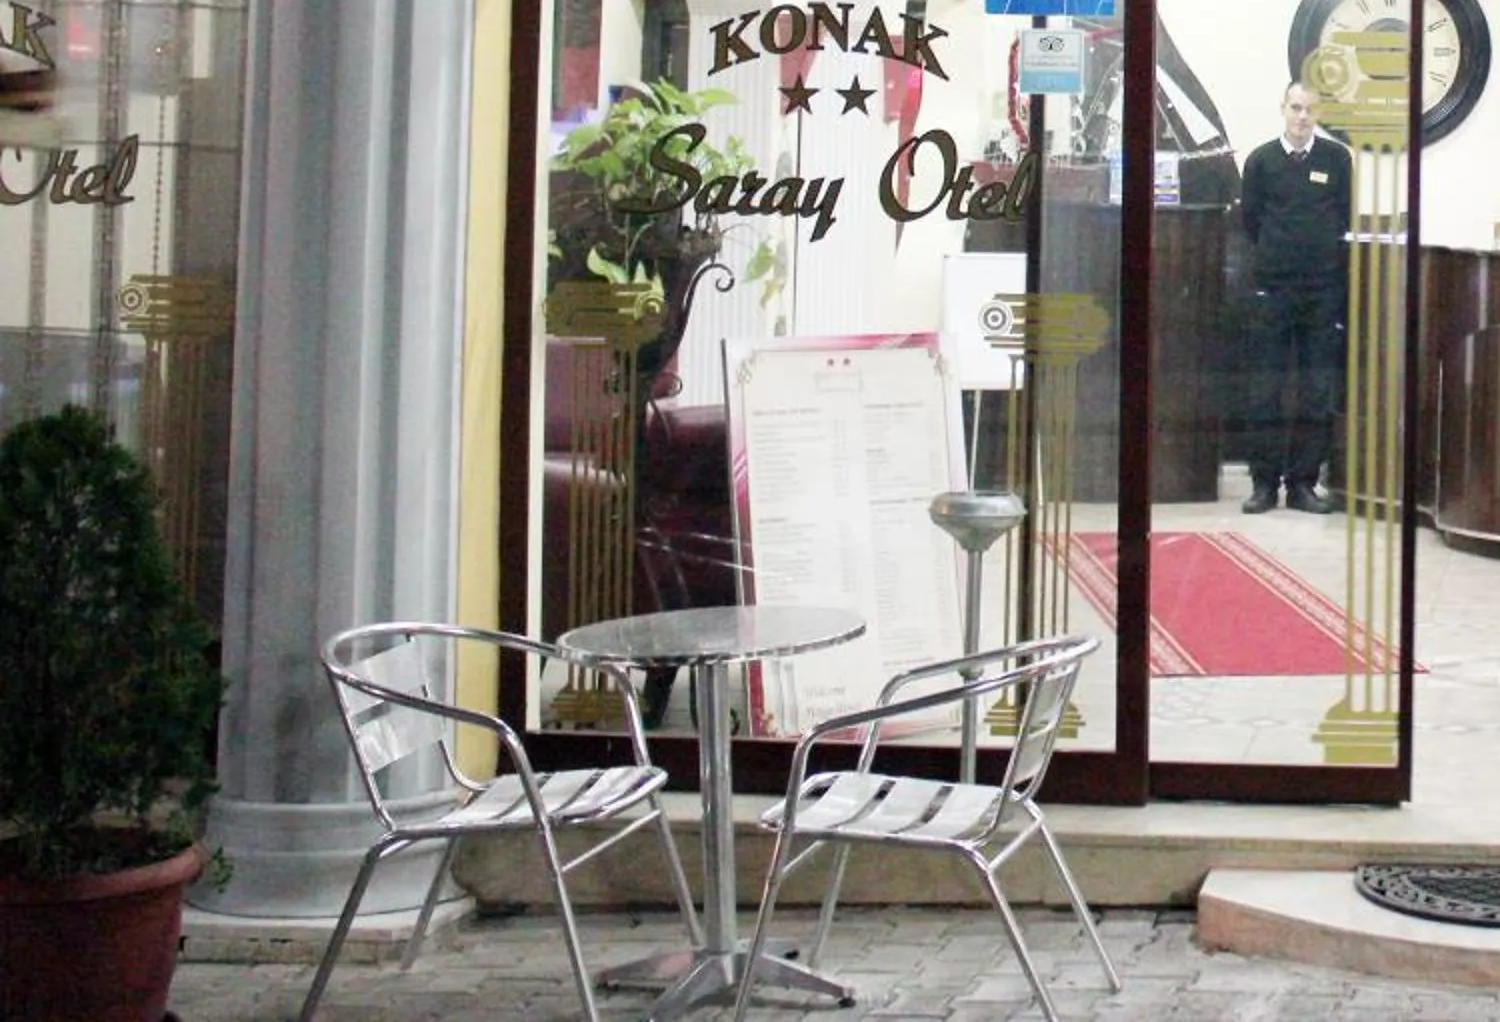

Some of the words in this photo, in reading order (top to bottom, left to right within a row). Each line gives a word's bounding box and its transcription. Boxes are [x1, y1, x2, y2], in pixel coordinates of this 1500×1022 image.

[707, 1, 950, 81] KONAK
[609, 122, 845, 243] Saray
[879, 129, 1042, 222] Otel
